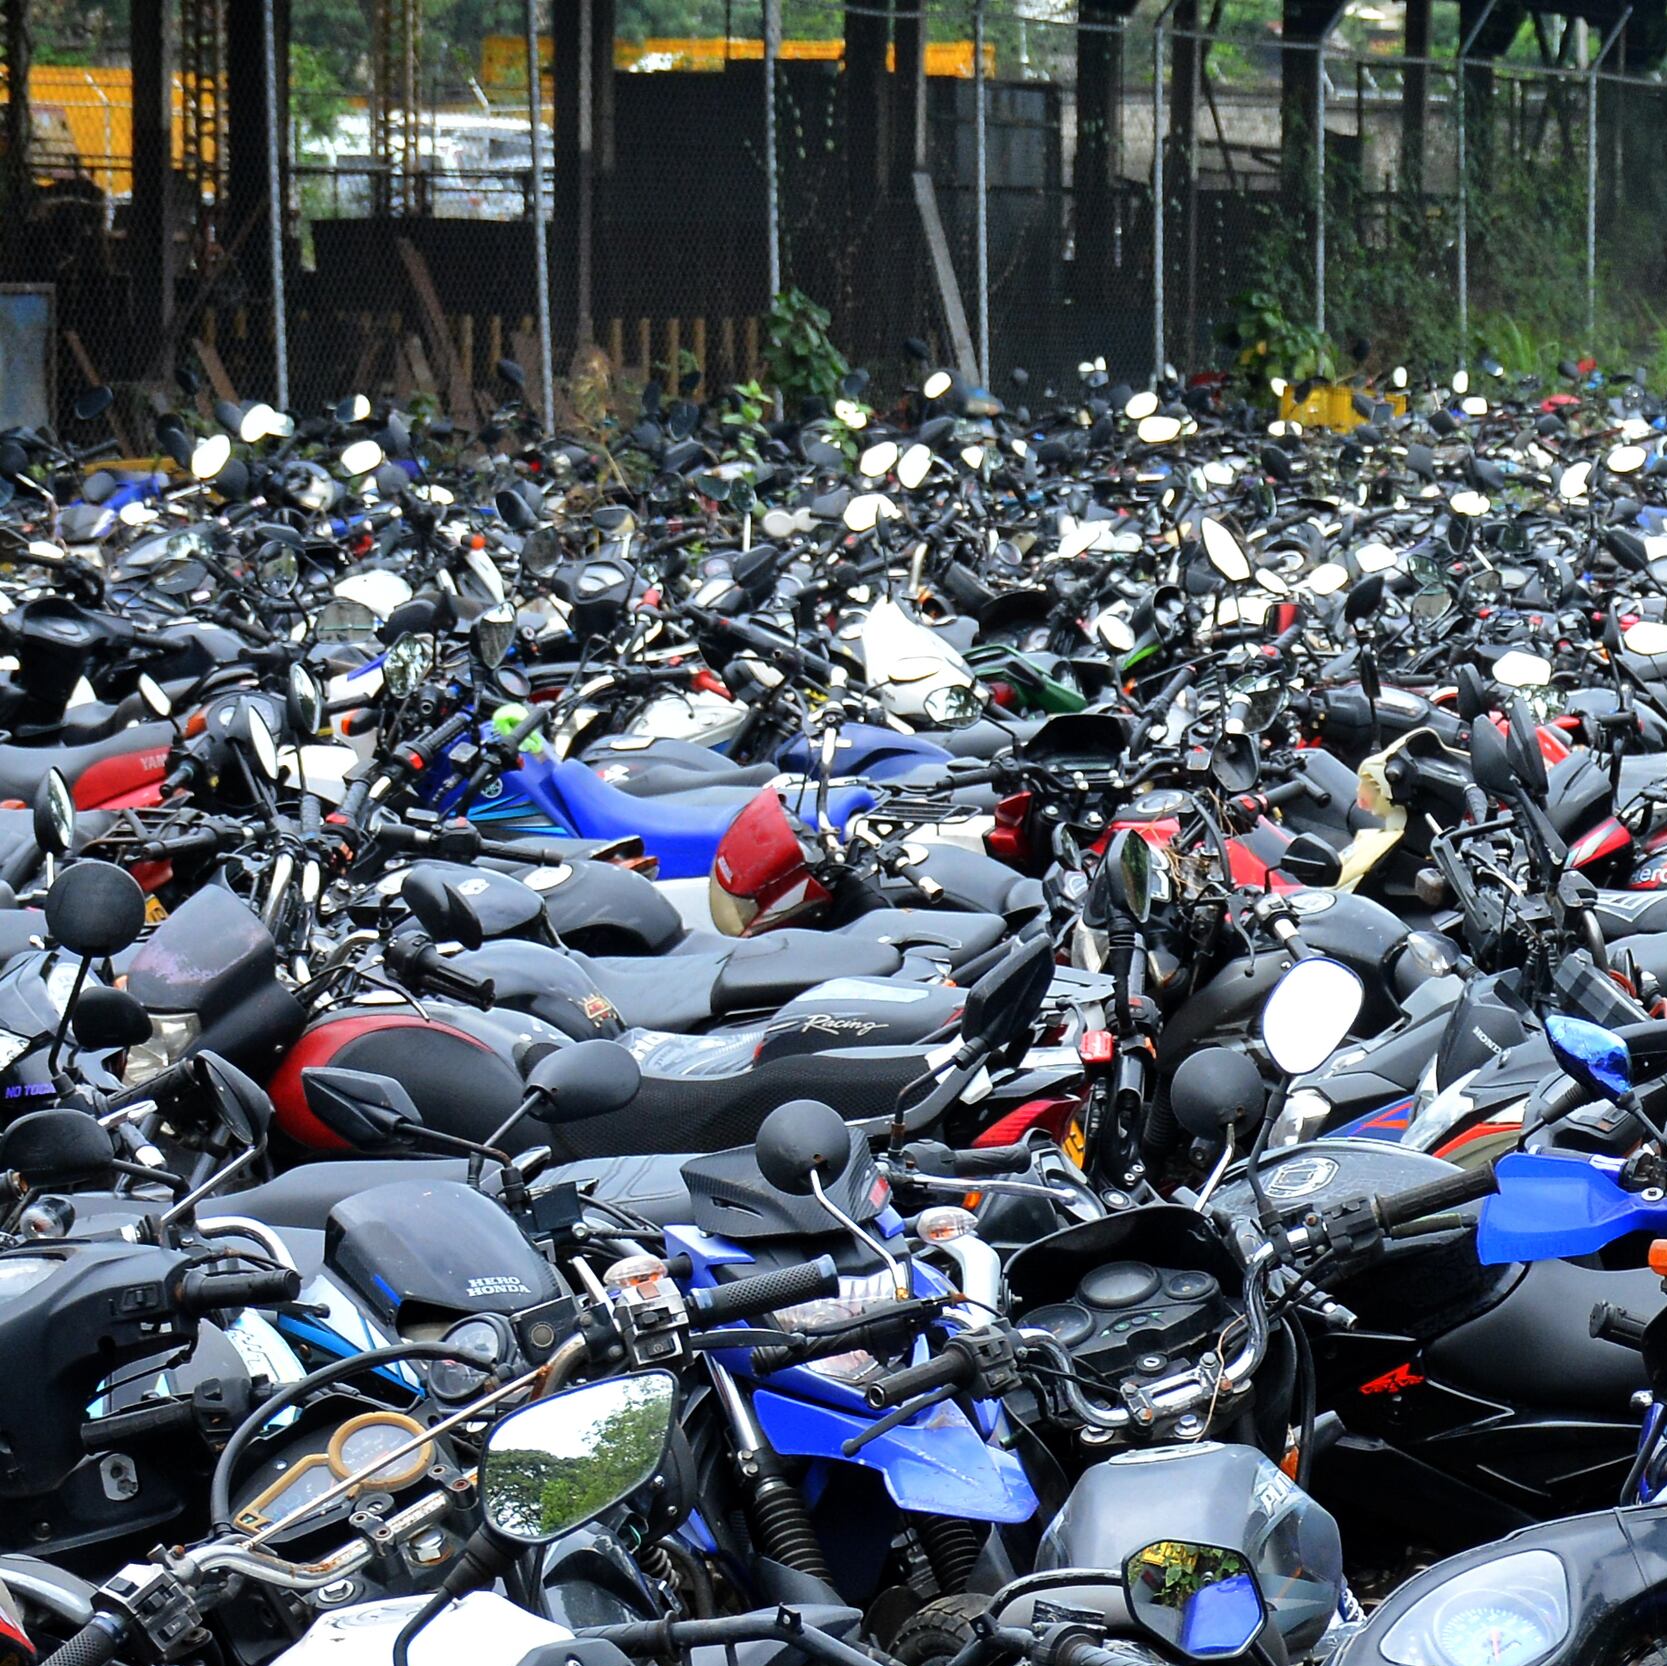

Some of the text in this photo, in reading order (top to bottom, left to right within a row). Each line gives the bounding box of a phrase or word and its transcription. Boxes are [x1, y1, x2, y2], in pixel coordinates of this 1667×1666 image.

[802, 1013, 889, 1037] Racing
[1472, 1025, 1504, 1056] HOND
[466, 1283, 532, 1297] HONDA
[468, 1276, 521, 1287] HERO
